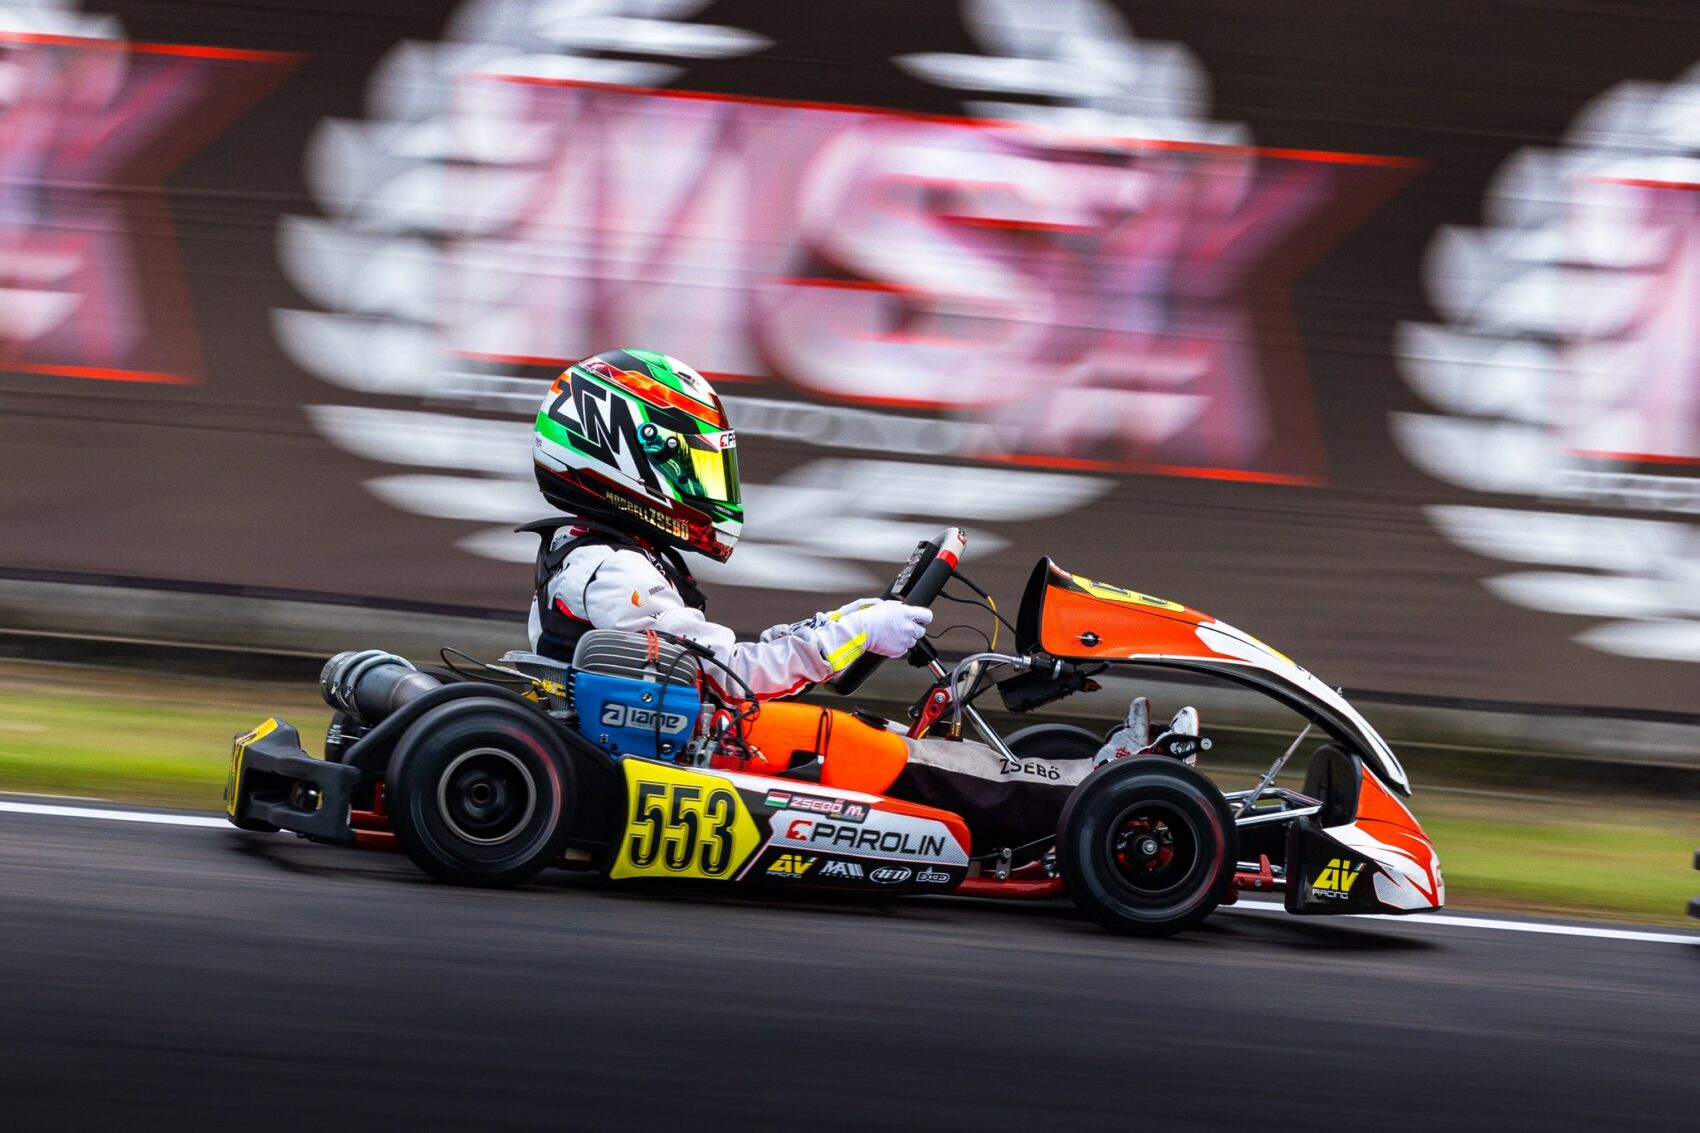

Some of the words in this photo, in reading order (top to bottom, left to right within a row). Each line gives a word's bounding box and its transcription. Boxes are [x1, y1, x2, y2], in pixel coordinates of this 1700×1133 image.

[626, 780, 737, 877] 553
[810, 822, 946, 857] PAROLIN
[767, 854, 813, 874] AV
[1311, 858, 1360, 892] AV
[1311, 888, 1349, 900] RACING
